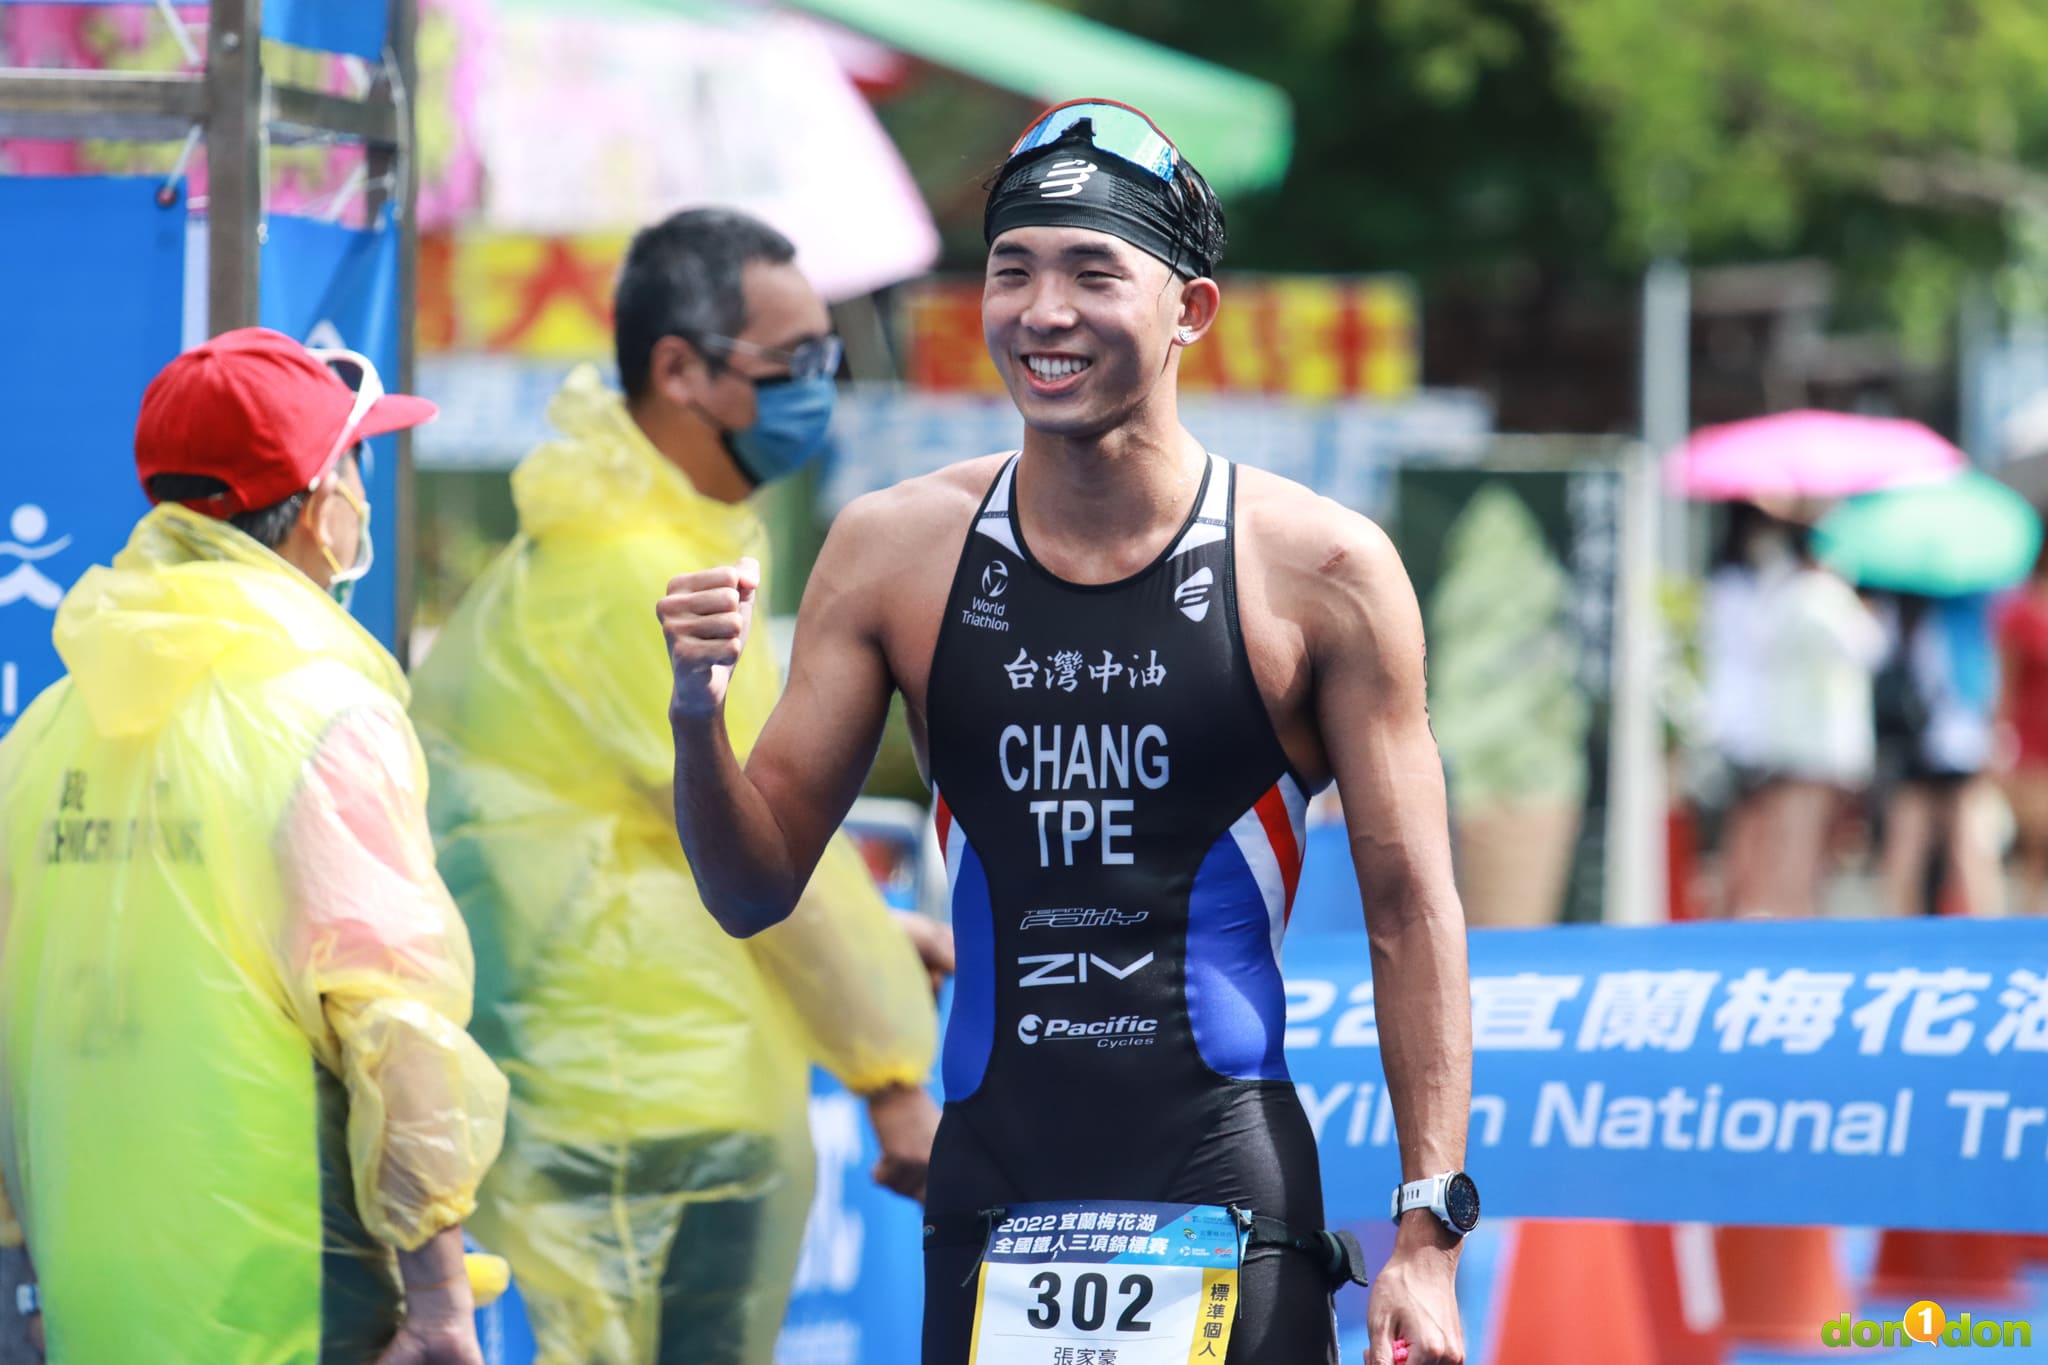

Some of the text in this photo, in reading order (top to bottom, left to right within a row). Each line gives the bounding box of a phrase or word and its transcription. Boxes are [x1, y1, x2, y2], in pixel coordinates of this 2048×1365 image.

[962, 610, 1009, 632] Triathlon
[971, 597, 1005, 616] World
[1003, 648, 1167, 693] 台灣中油
[999, 724, 1169, 791] CHANG
[1029, 799, 1134, 867] TPE
[1018, 952, 1154, 987] ZIV
[1044, 1016, 1158, 1037] Pacific
[1097, 1037, 1154, 1049] Cycles
[1298, 1081, 2048, 1161] Yiln National Tr
[997, 1212, 1158, 1233] 2022 宜蘭梅花湖
[1027, 1271, 1154, 1332] 302
[1198, 1283, 1230, 1358] 標準個人
[1054, 1347, 1118, 1365] 張家豪
